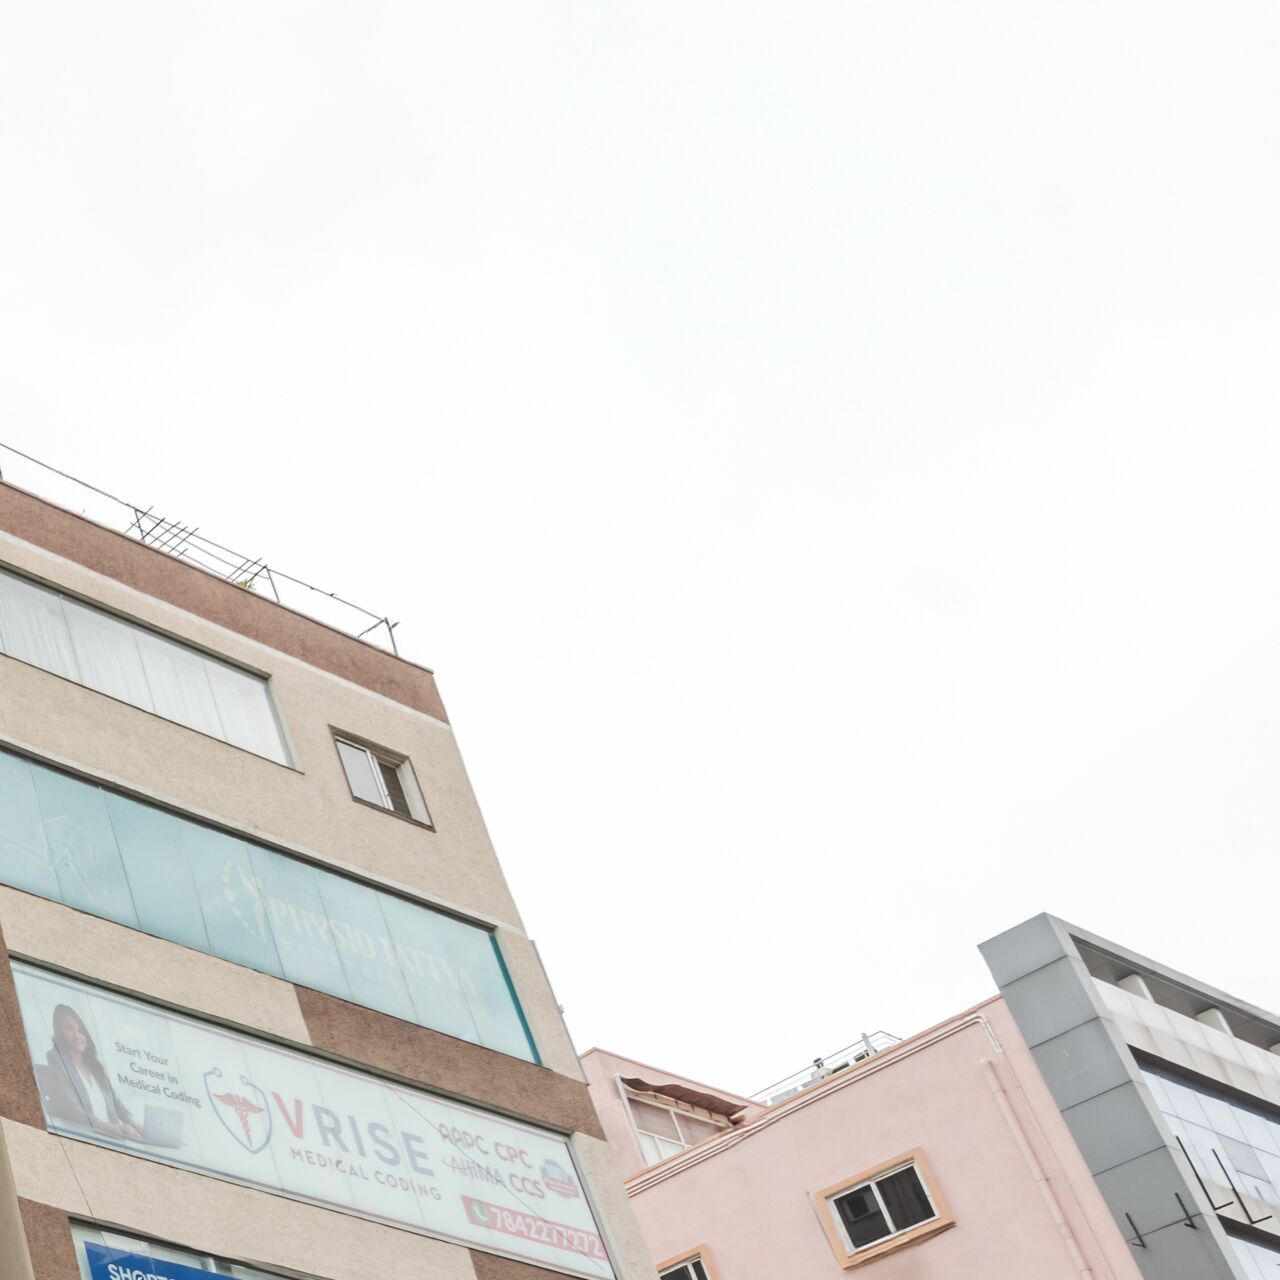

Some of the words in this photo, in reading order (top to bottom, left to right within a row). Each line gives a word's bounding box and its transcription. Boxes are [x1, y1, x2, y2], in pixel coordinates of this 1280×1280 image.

[115, 1041, 141, 1057] Start
[143, 1050, 169, 1066] Your
[130, 1062, 165, 1081] Career
[168, 1074, 179, 1085] in
[117, 1074, 161, 1096] Medical
[163, 1087, 202, 1109] Coding
[272, 1091, 436, 1178] VRISE
[438, 1123, 490, 1156] AAPC
[494, 1141, 533, 1169] CPC
[290, 1147, 370, 1182] MEDICAL
[373, 1170, 442, 1202] CODING
[508, 1174, 546, 1200] CCS
